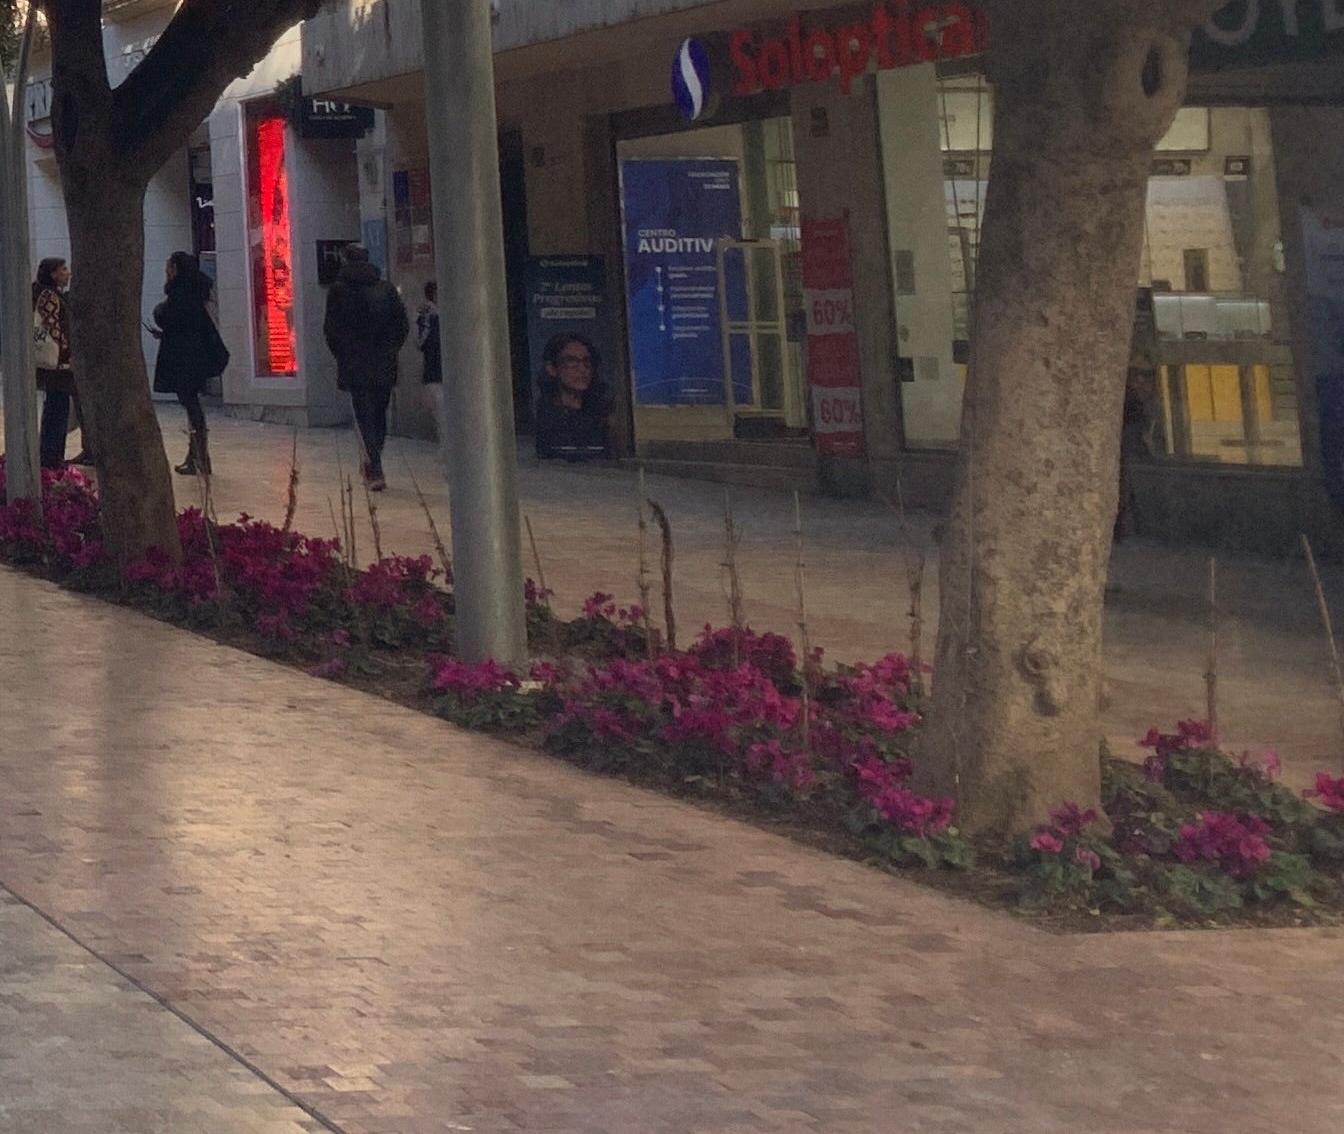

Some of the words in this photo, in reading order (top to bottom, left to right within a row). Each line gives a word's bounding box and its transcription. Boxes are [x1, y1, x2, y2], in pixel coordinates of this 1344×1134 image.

[638, 229, 676, 238] CENTRO
[638, 237, 726, 254] AUDITIV
[813, 299, 850, 326] 60%
